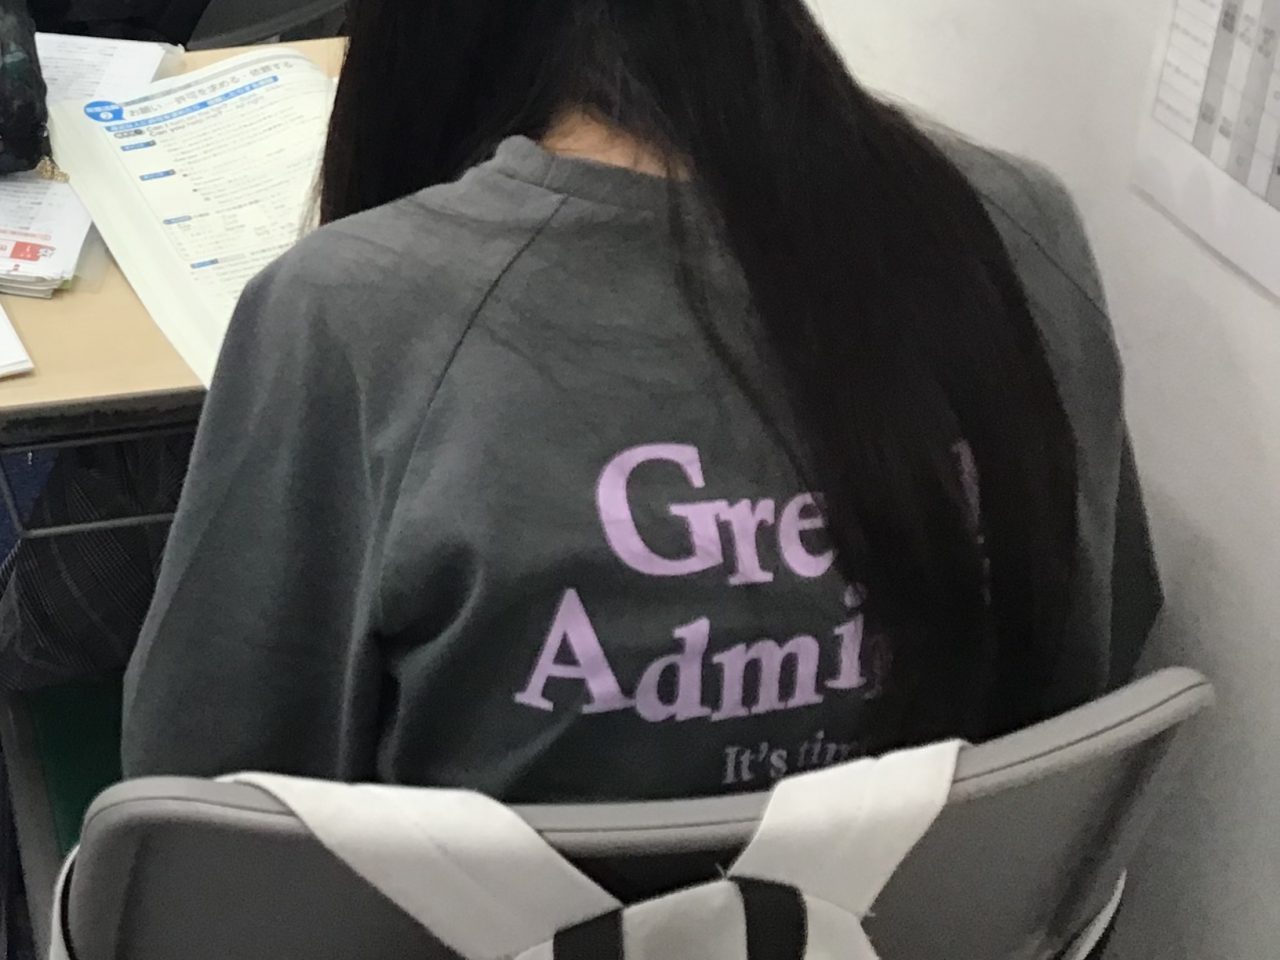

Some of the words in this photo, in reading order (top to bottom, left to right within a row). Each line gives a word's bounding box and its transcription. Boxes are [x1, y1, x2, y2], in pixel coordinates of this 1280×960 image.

[596, 442, 835, 587] Gre
[515, 582, 870, 723] Admi
[723, 742, 788, 784] It's
